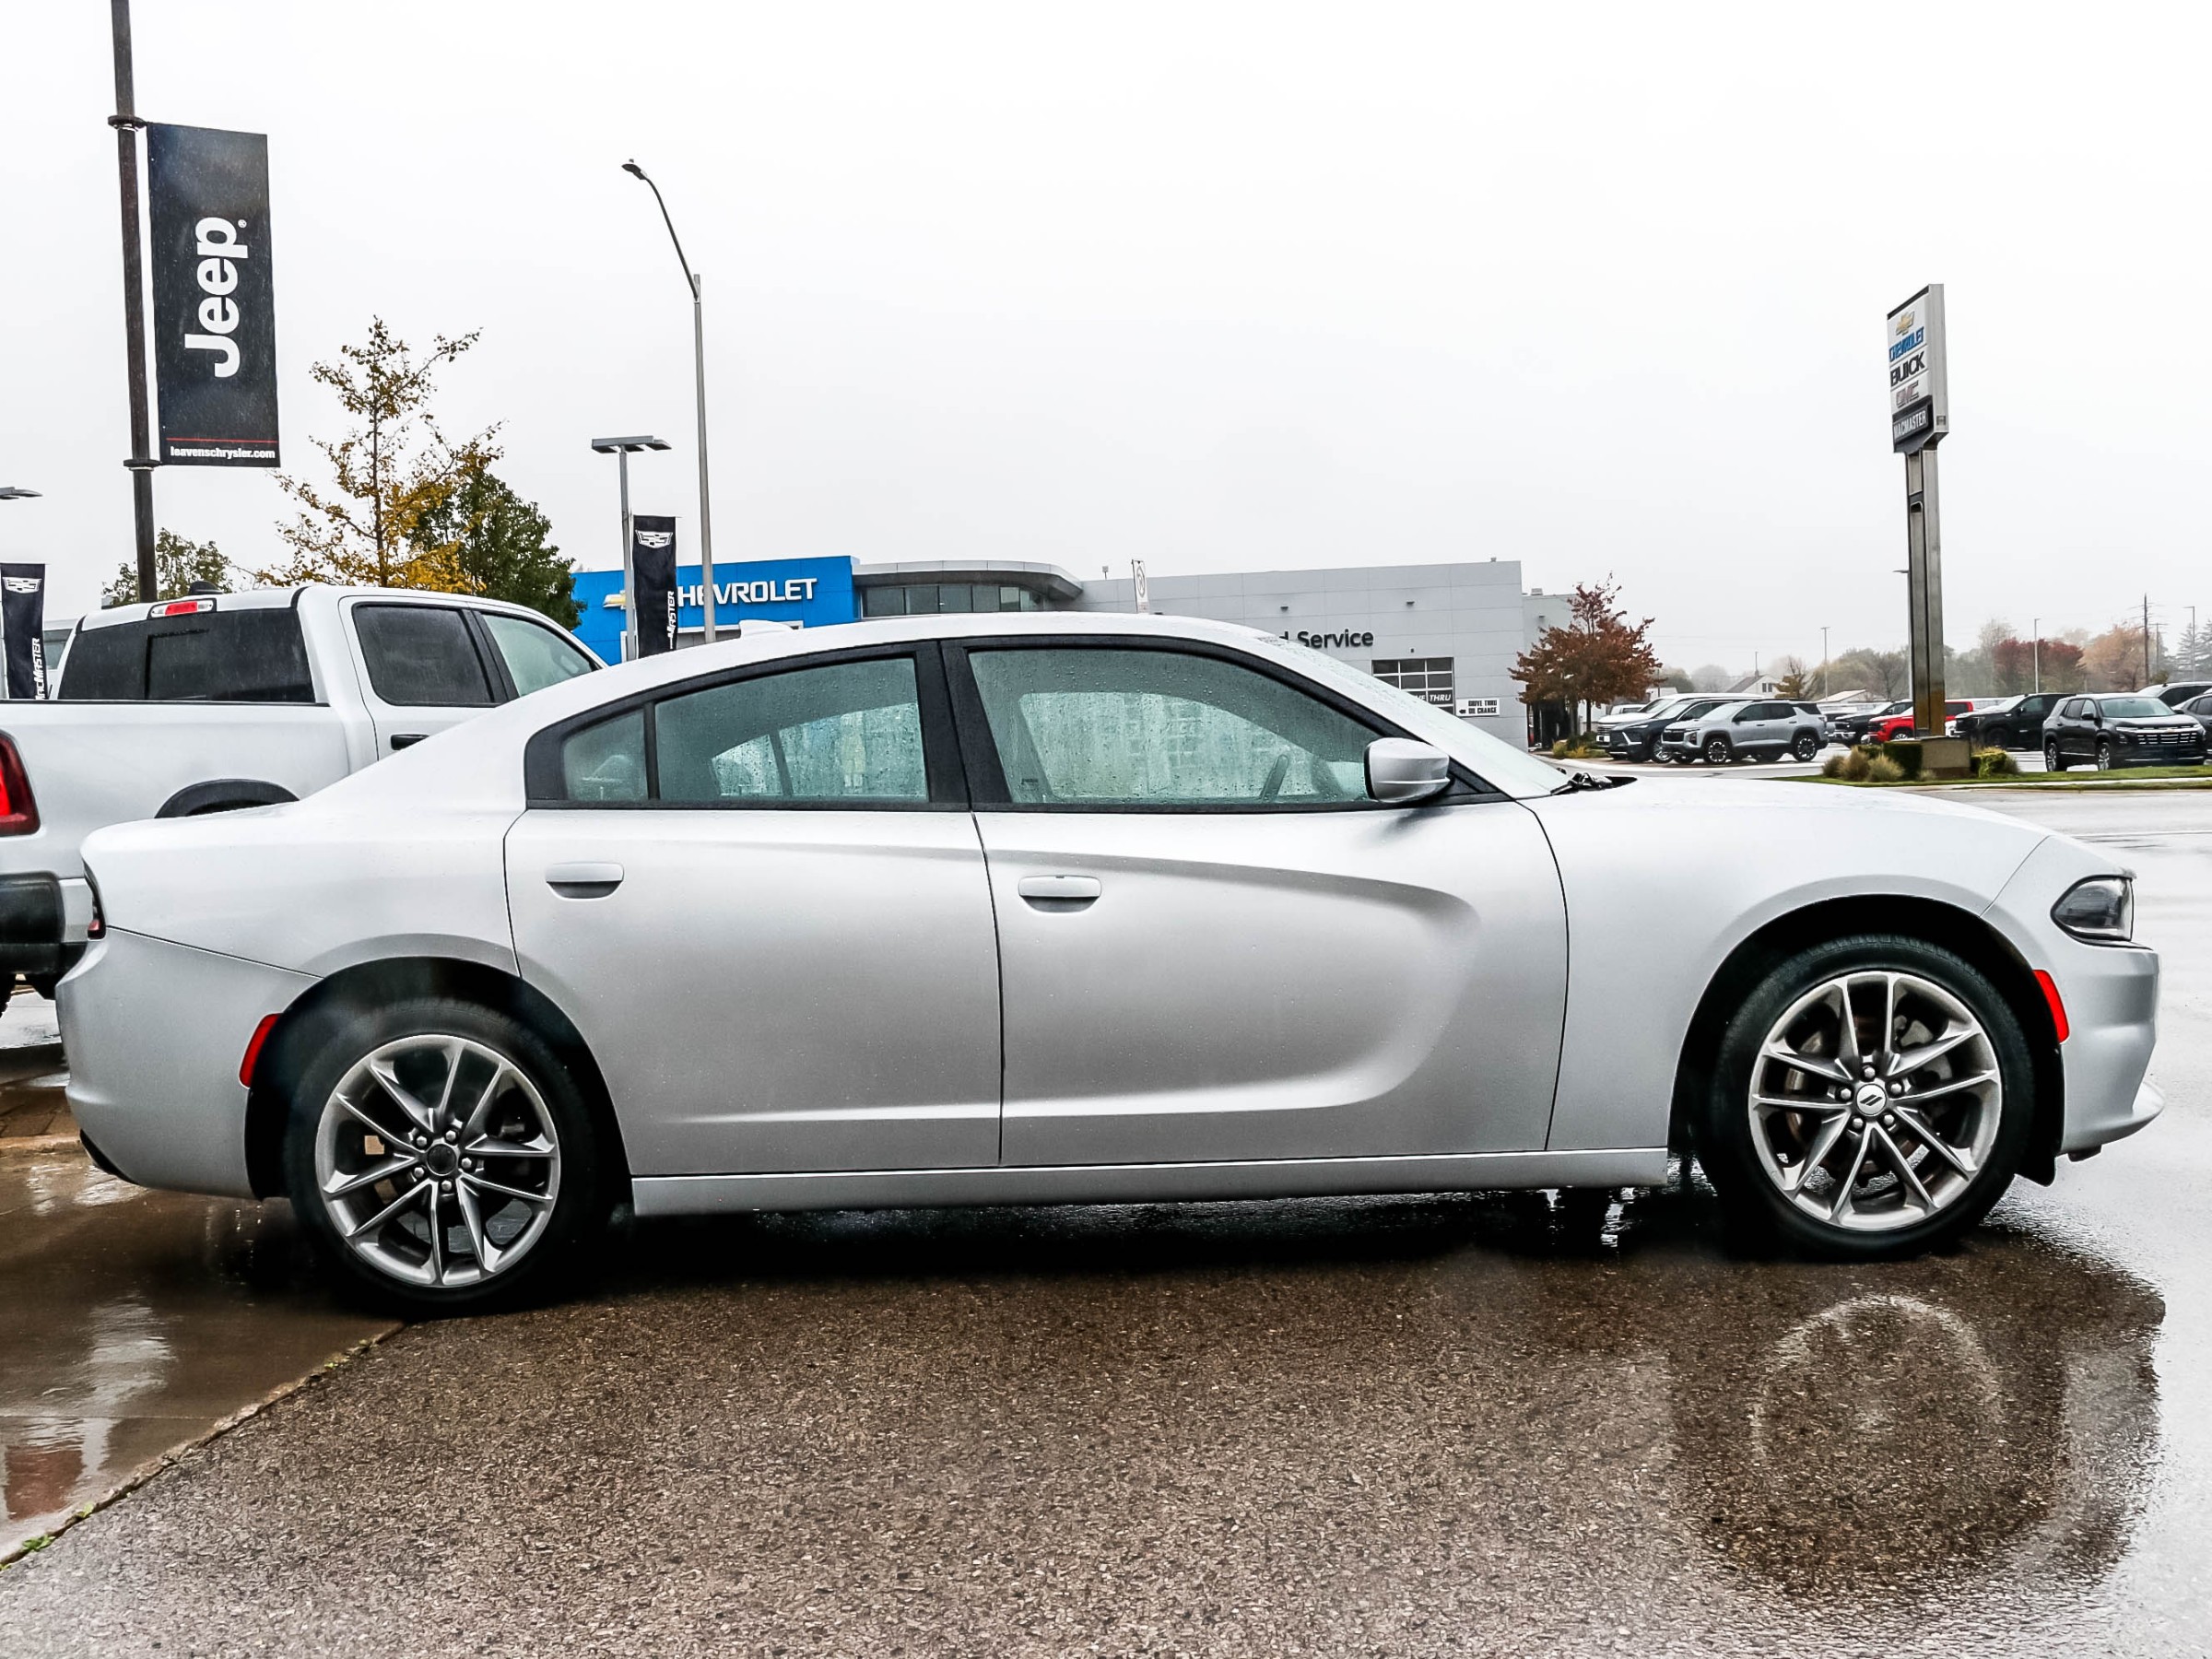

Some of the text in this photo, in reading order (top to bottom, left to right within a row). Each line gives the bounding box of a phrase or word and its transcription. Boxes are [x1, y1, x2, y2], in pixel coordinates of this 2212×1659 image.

[184, 217, 249, 378] Jeep
[1889, 326, 1924, 362] CHEVROLET
[1890, 350, 1925, 387] BUICK
[170, 445, 276, 460] leavenschrysler.com
[677, 578, 818, 606] HVROLET
[1297, 629, 1374, 649] Service
